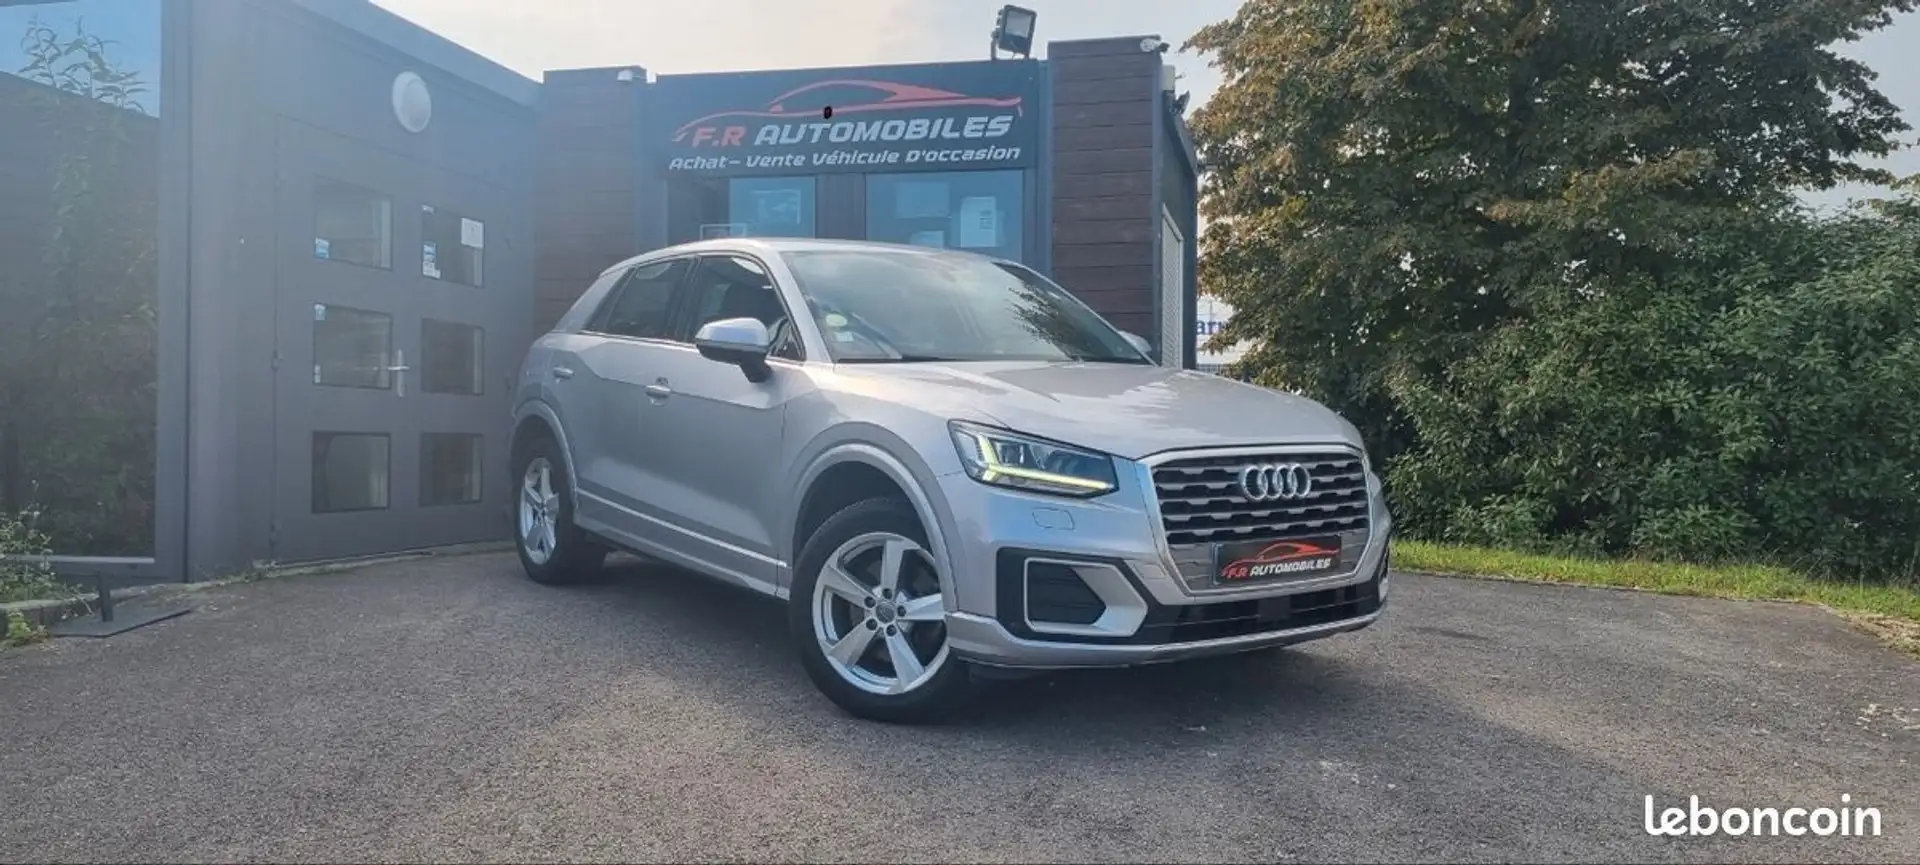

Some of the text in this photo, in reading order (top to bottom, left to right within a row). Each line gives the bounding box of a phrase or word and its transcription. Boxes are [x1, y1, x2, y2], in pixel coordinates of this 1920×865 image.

[692, 115, 1014, 148] F.R AUTOMOBILES
[746, 153, 806, 169] Vente
[812, 149, 900, 166] Véhicule
[905, 145, 1021, 163] D'occasion
[1250, 558, 1332, 577] AUTOMOBILES
